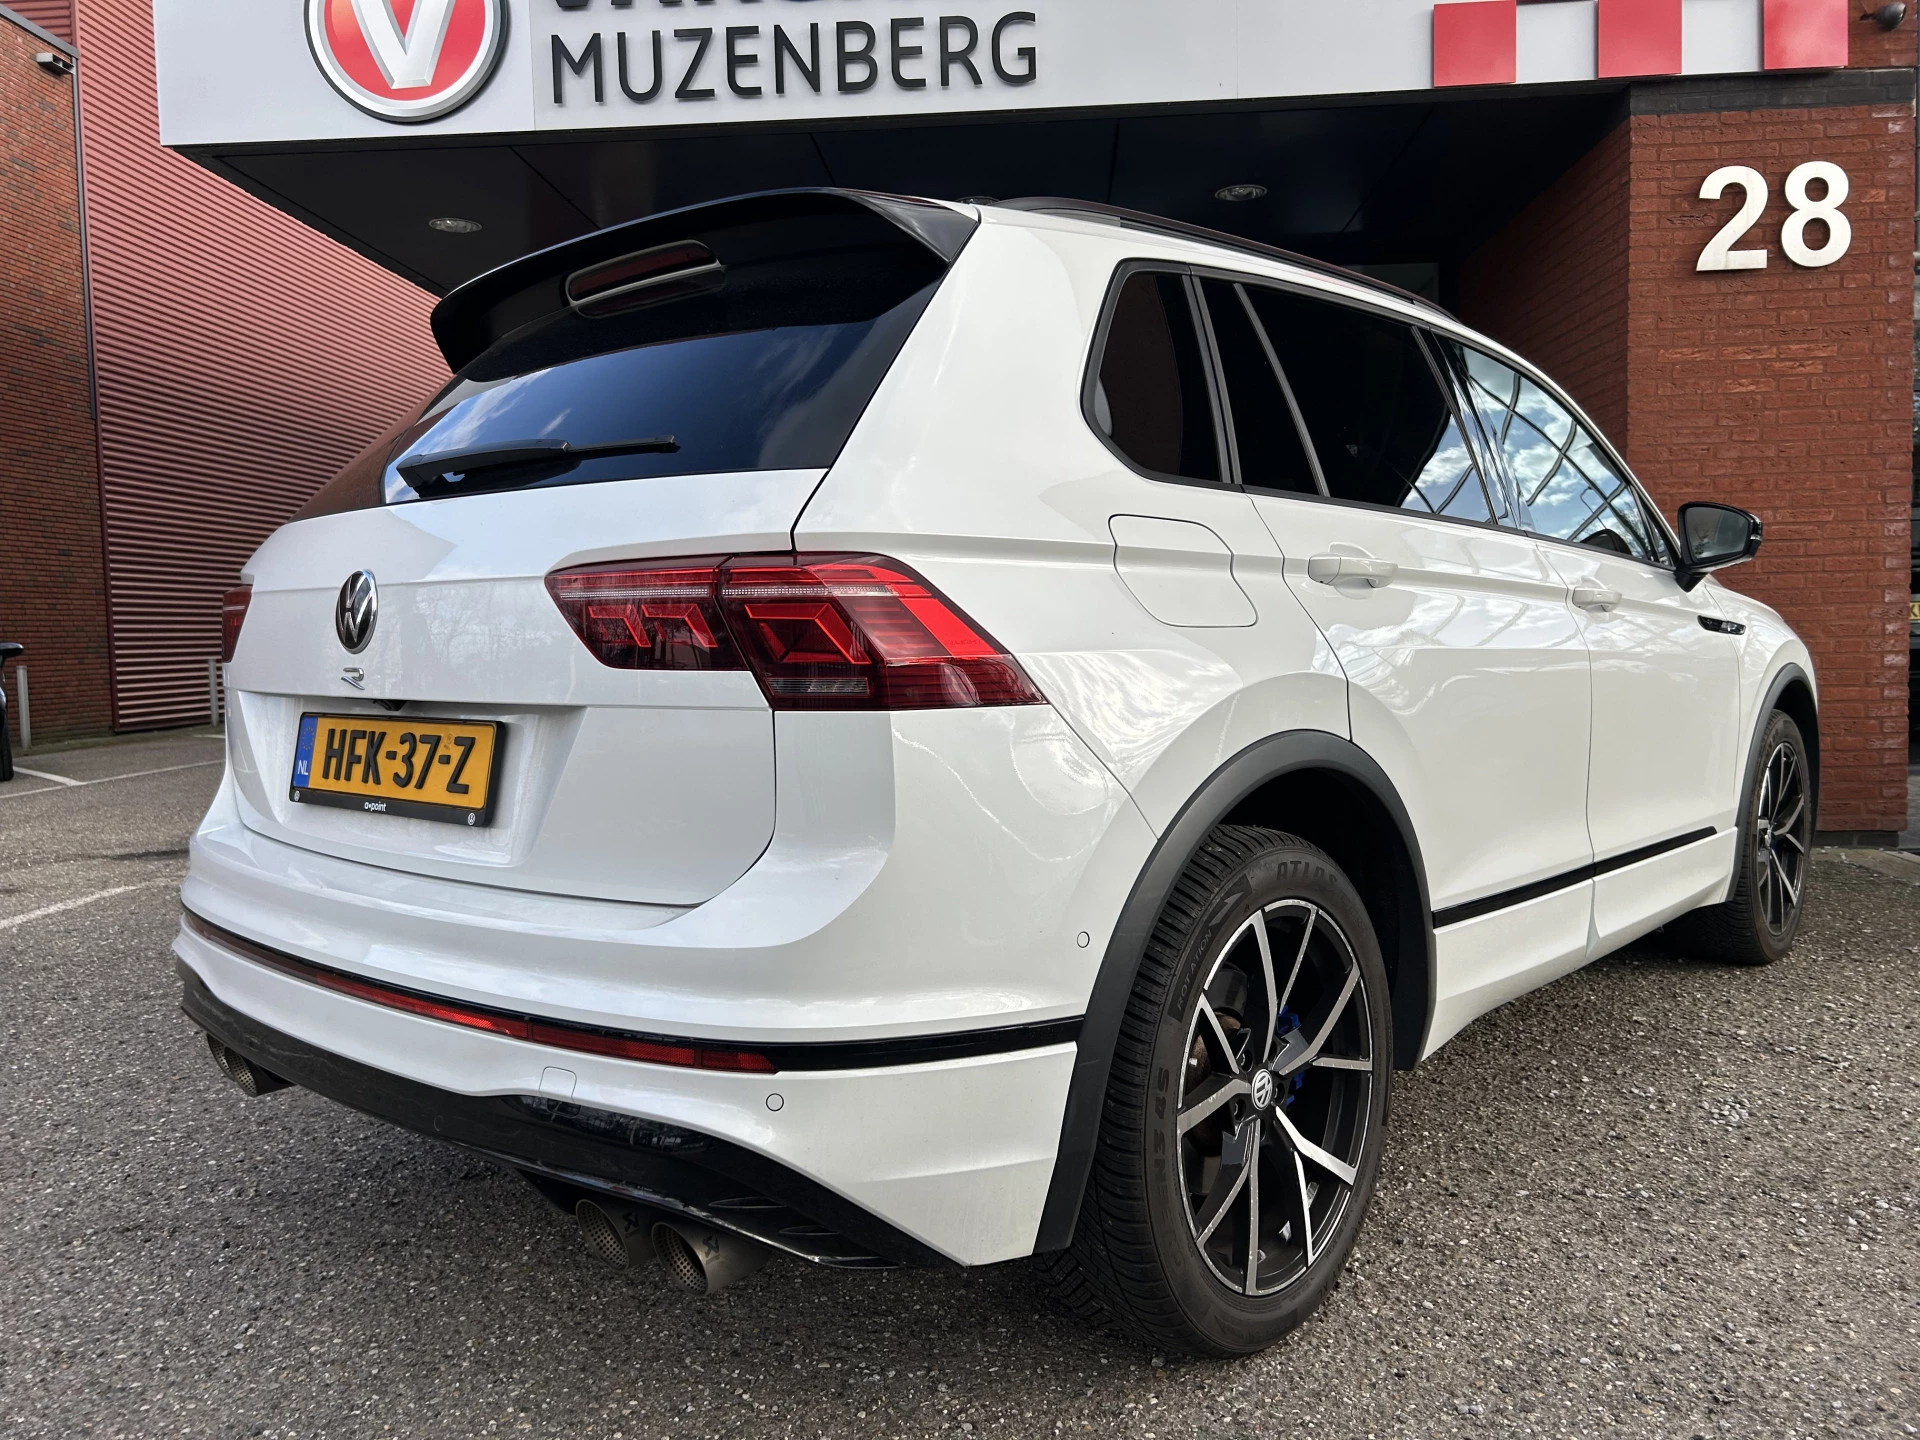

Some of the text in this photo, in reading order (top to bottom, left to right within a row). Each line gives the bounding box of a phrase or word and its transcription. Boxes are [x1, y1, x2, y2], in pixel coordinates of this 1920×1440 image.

[551, 11, 1037, 105] MUZENBERG
[1696, 160, 1852, 269] 28
[297, 760, 309, 776] NL
[322, 728, 476, 795] HFK-37-Z
[1176, 928, 1213, 1012] ROTATION
